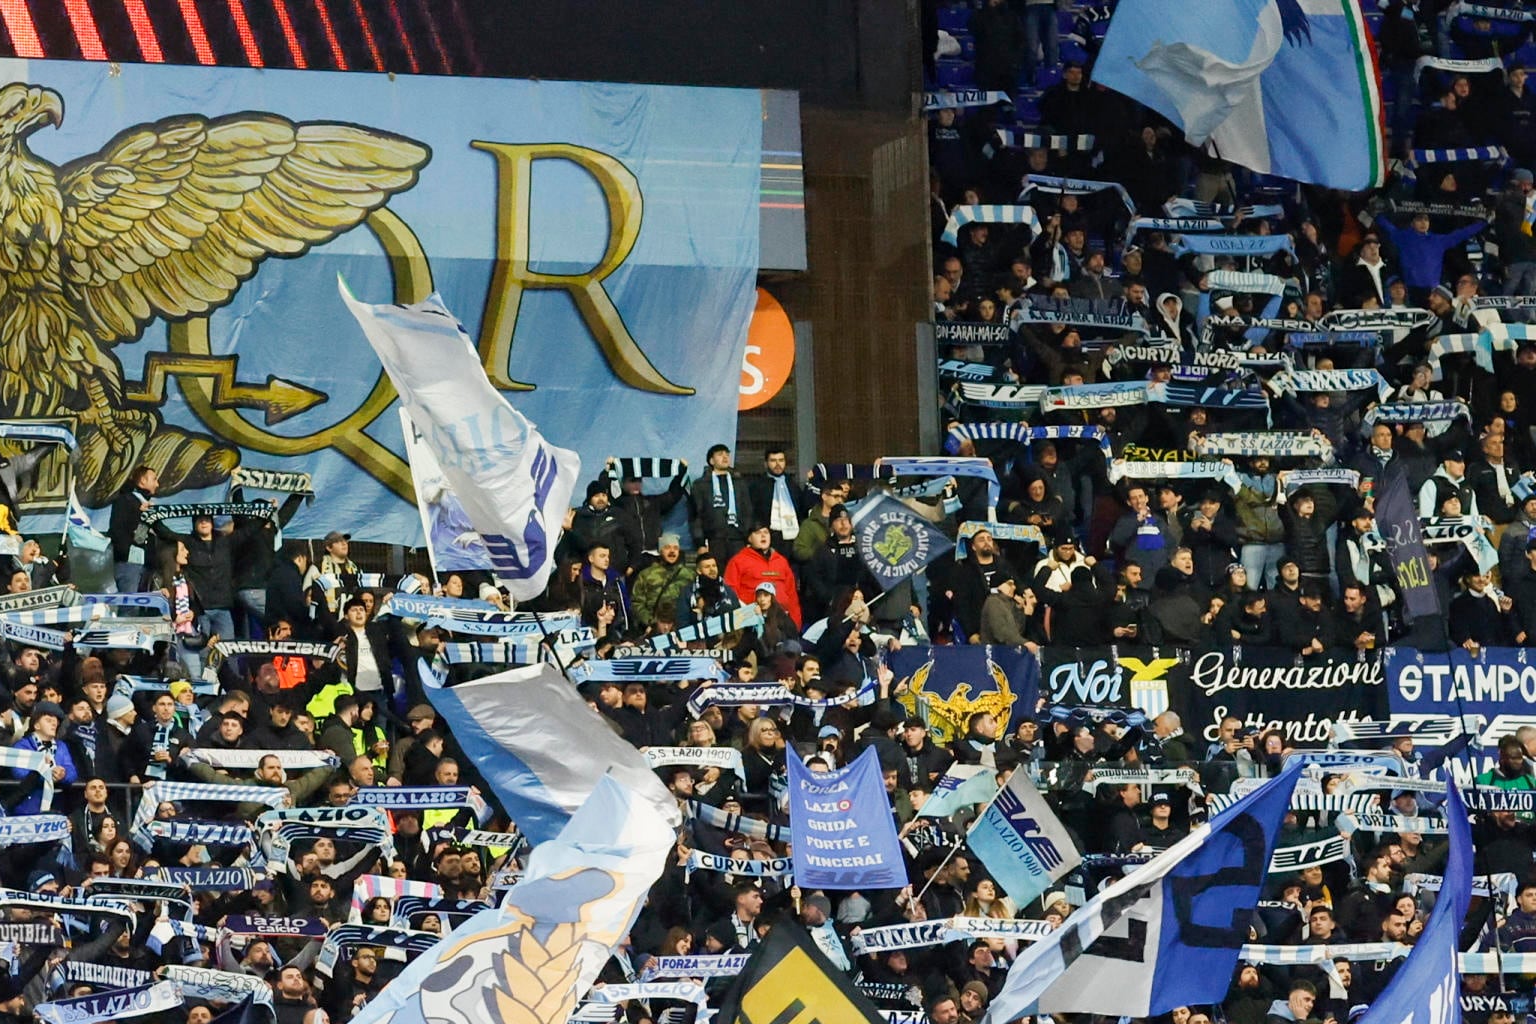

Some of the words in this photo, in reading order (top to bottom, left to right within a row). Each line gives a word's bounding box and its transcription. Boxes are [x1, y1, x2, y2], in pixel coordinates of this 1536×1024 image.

[1127, 345, 1181, 363] CURVA
[1194, 352, 1239, 370] NORD
[217, 640, 339, 658] IRRIDUCIBILI
[1190, 650, 1384, 696] Generazione
[1049, 659, 1123, 705] Noi
[672, 747, 703, 758] LAZIO
[357, 792, 405, 805] FORZA
[409, 791, 458, 804] LAZIO
[1491, 792, 1533, 810] LAZIO
[288, 807, 368, 823] LAZIO
[1356, 815, 1398, 829] FORZA
[807, 818, 857, 831] GRIDA
[169, 822, 249, 845] LAZIO
[806, 836, 853, 849] FORTE
[858, 835, 870, 847] E
[701, 855, 754, 872] CURVA
[806, 853, 884, 868] VINCERAI
[256, 924, 301, 934] calcio
[662, 957, 700, 969] FORZA
